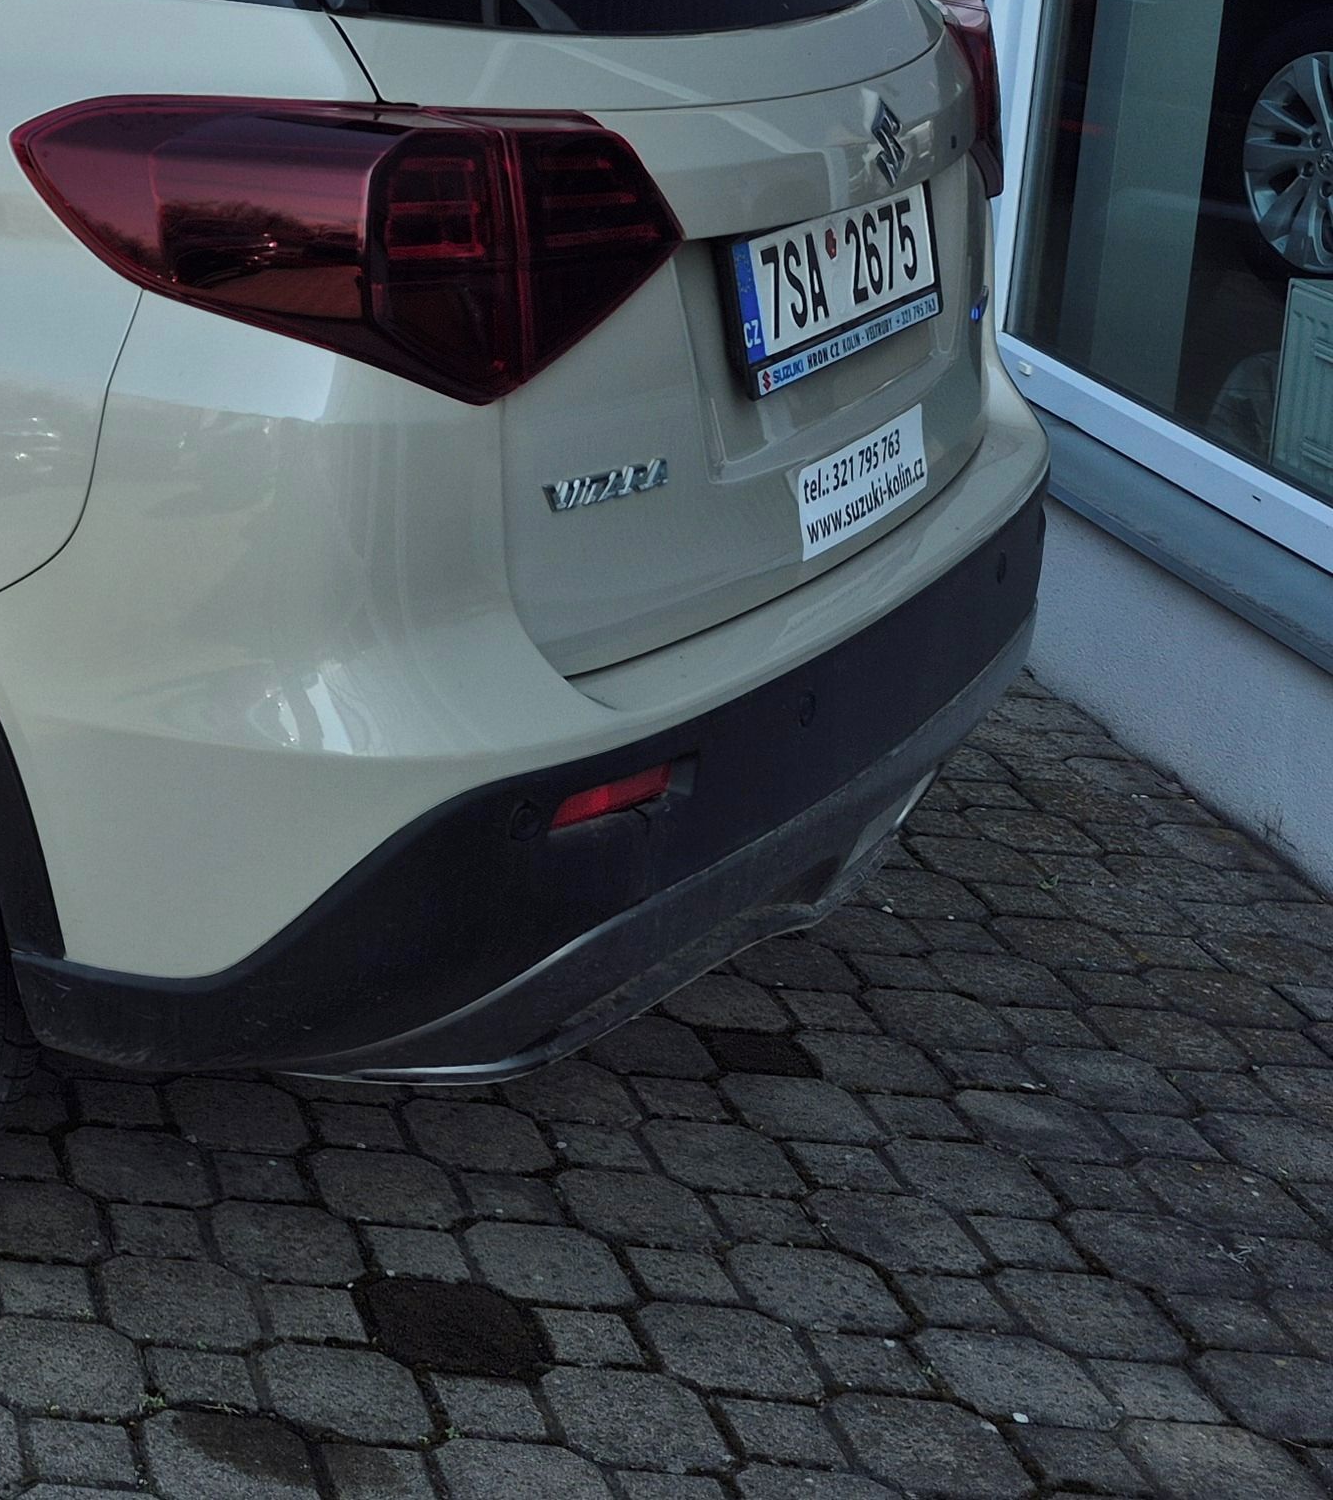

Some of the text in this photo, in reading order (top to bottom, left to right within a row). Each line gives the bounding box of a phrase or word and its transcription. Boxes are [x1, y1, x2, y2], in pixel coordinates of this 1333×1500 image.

[760, 197, 918, 340] 7SA 2675
[743, 319, 761, 349] CZ
[773, 359, 804, 384] SUZUKI
[807, 346, 829, 370] HRON
[830, 342, 840, 358] CZ
[542, 458, 668, 512] VITARA
[803, 428, 900, 504] tel.: 321 795 763
[806, 457, 925, 544] www.suzuki-kolin.cz
